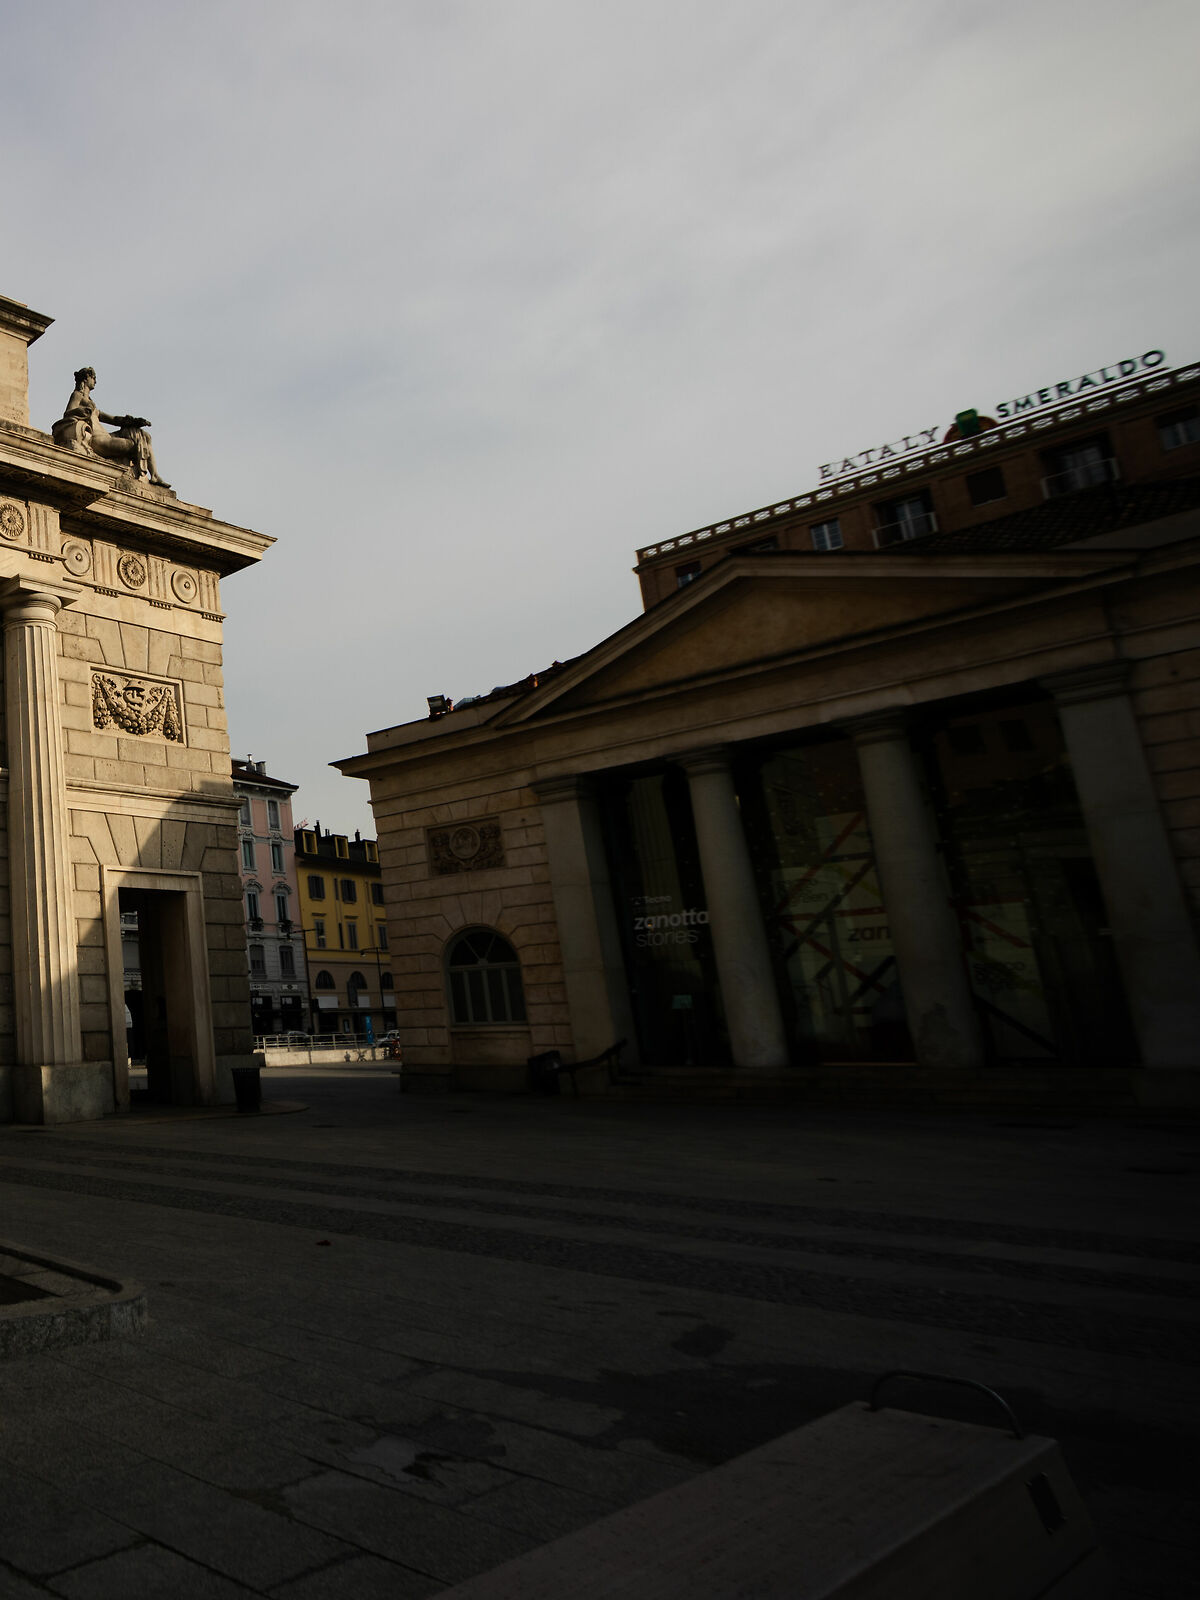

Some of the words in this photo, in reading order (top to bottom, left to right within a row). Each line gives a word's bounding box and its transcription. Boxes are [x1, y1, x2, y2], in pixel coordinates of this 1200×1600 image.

[817, 425, 938, 480] EATALY
[996, 349, 1166, 418] SMERALDO
[634, 908, 709, 930] zanotta
[636, 930, 700, 948] stories
